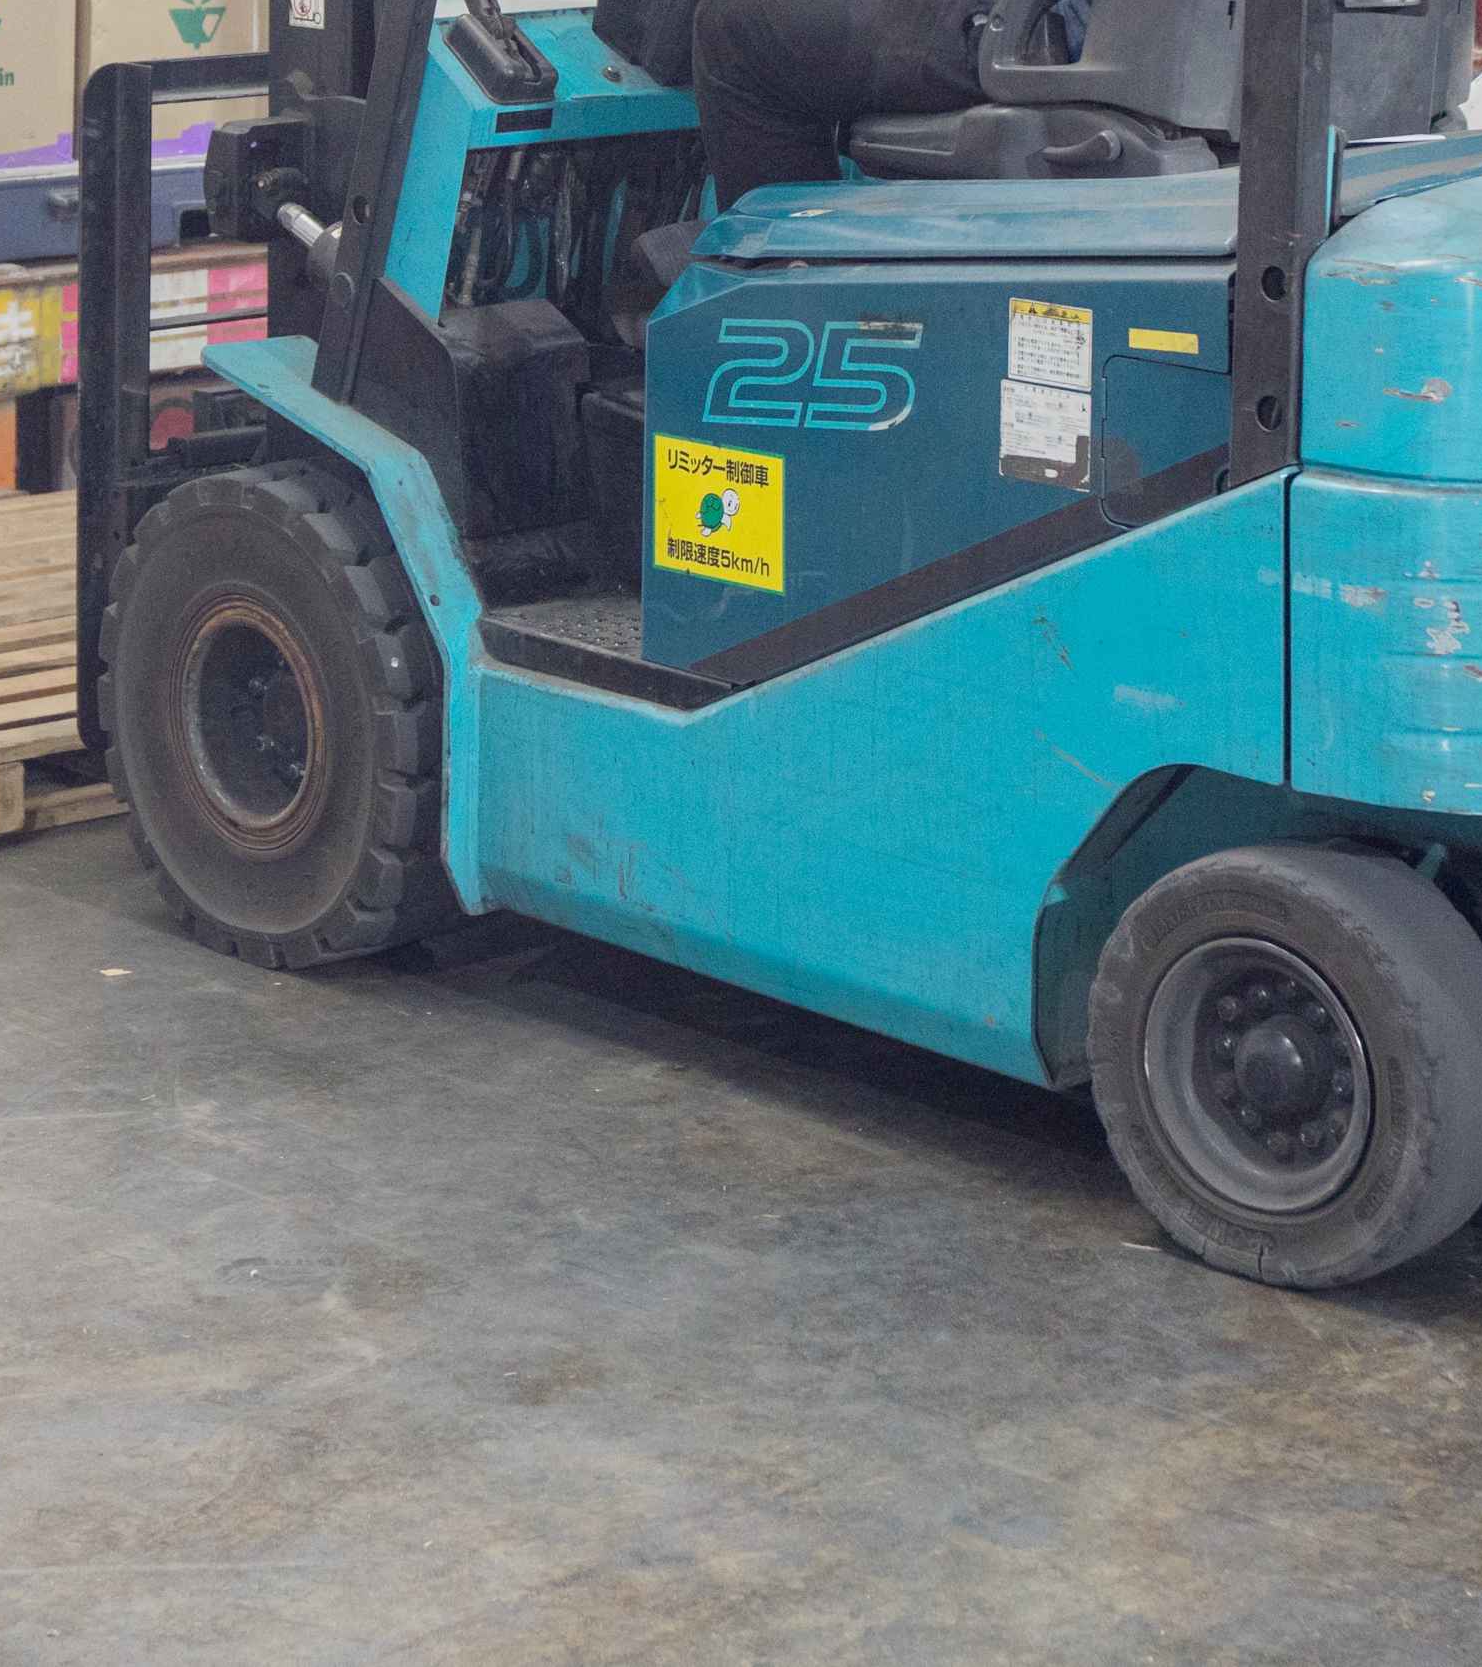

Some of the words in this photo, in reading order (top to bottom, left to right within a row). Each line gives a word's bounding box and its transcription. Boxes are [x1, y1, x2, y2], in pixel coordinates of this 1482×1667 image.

[702, 317, 924, 431] 25
[667, 448, 770, 489] リミッター制御車
[667, 536, 771, 578] 制限速度5km/h
